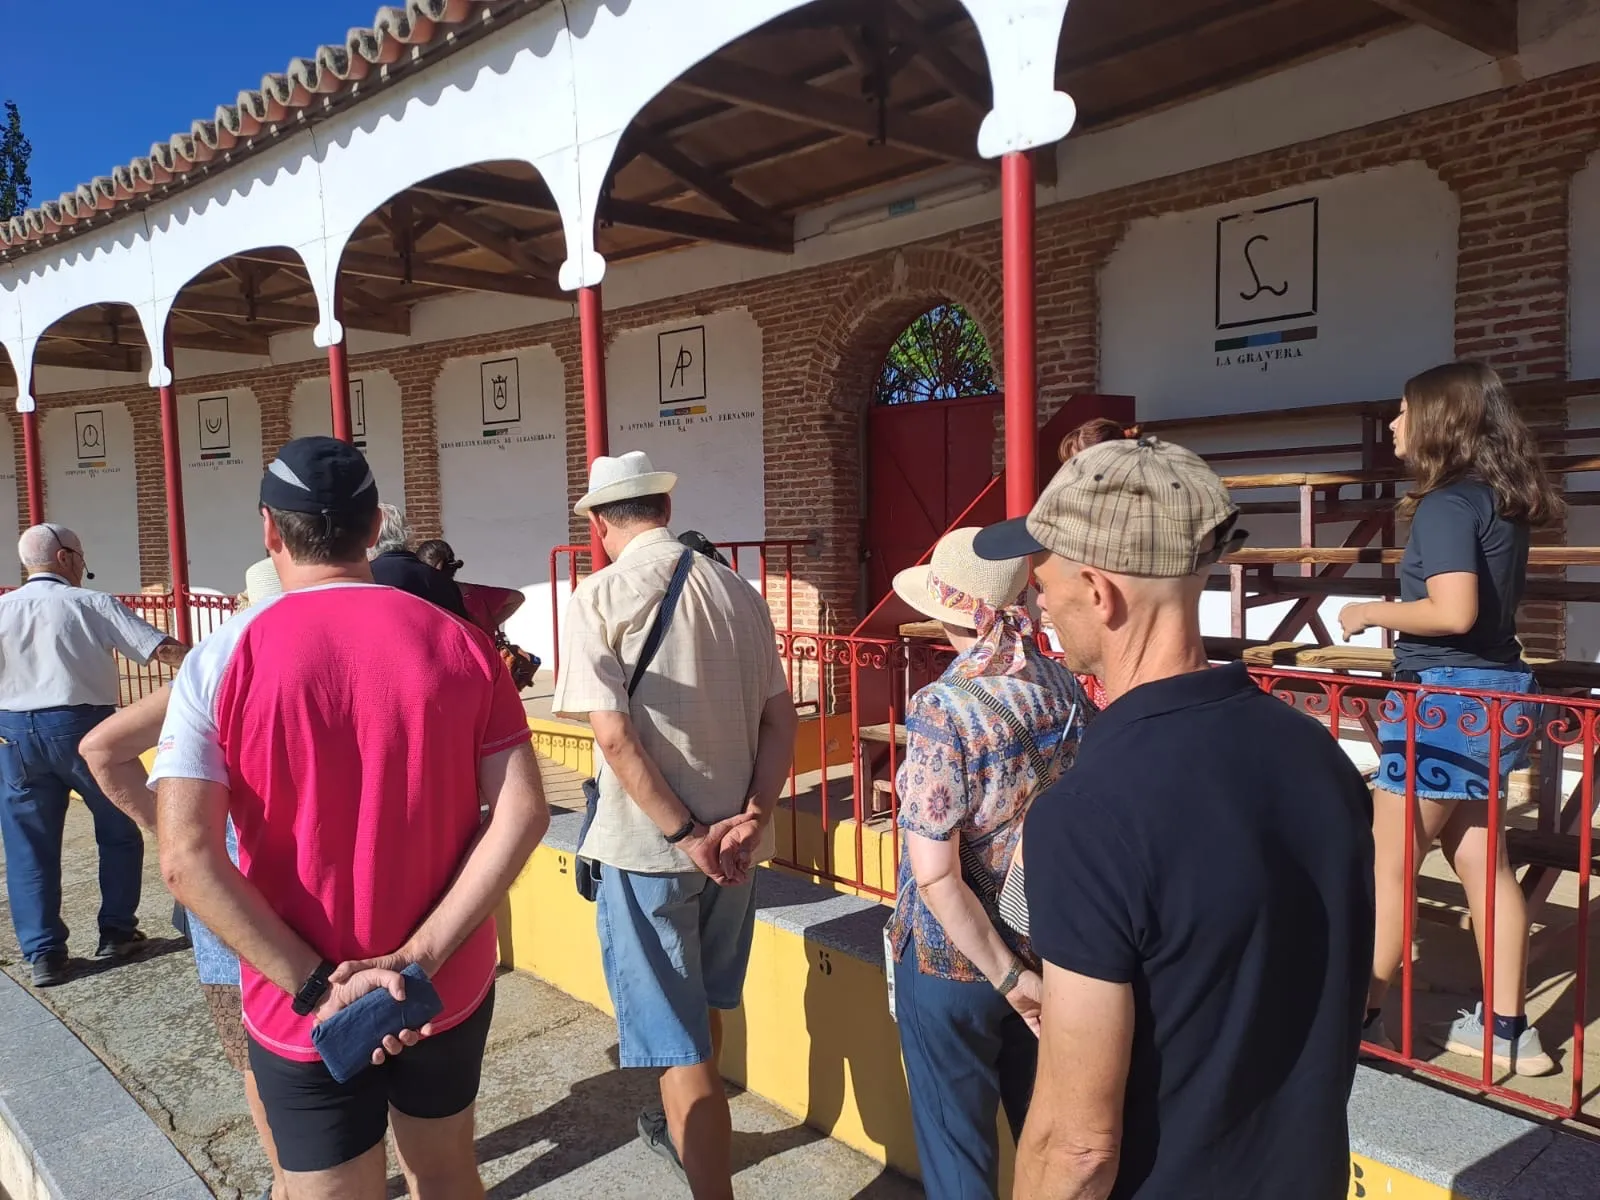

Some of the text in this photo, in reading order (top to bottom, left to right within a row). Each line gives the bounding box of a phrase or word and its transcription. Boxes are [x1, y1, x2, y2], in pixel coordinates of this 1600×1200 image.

[1216, 347, 1303, 366] LA GRAVERA
[628, 421, 654, 431] ANTONIO
[685, 416, 694, 425] DE
[700, 415, 713, 423] SAN
[718, 411, 755, 421] FERNANDO
[558, 855, 567, 874] 2
[819, 950, 832, 976] 5
